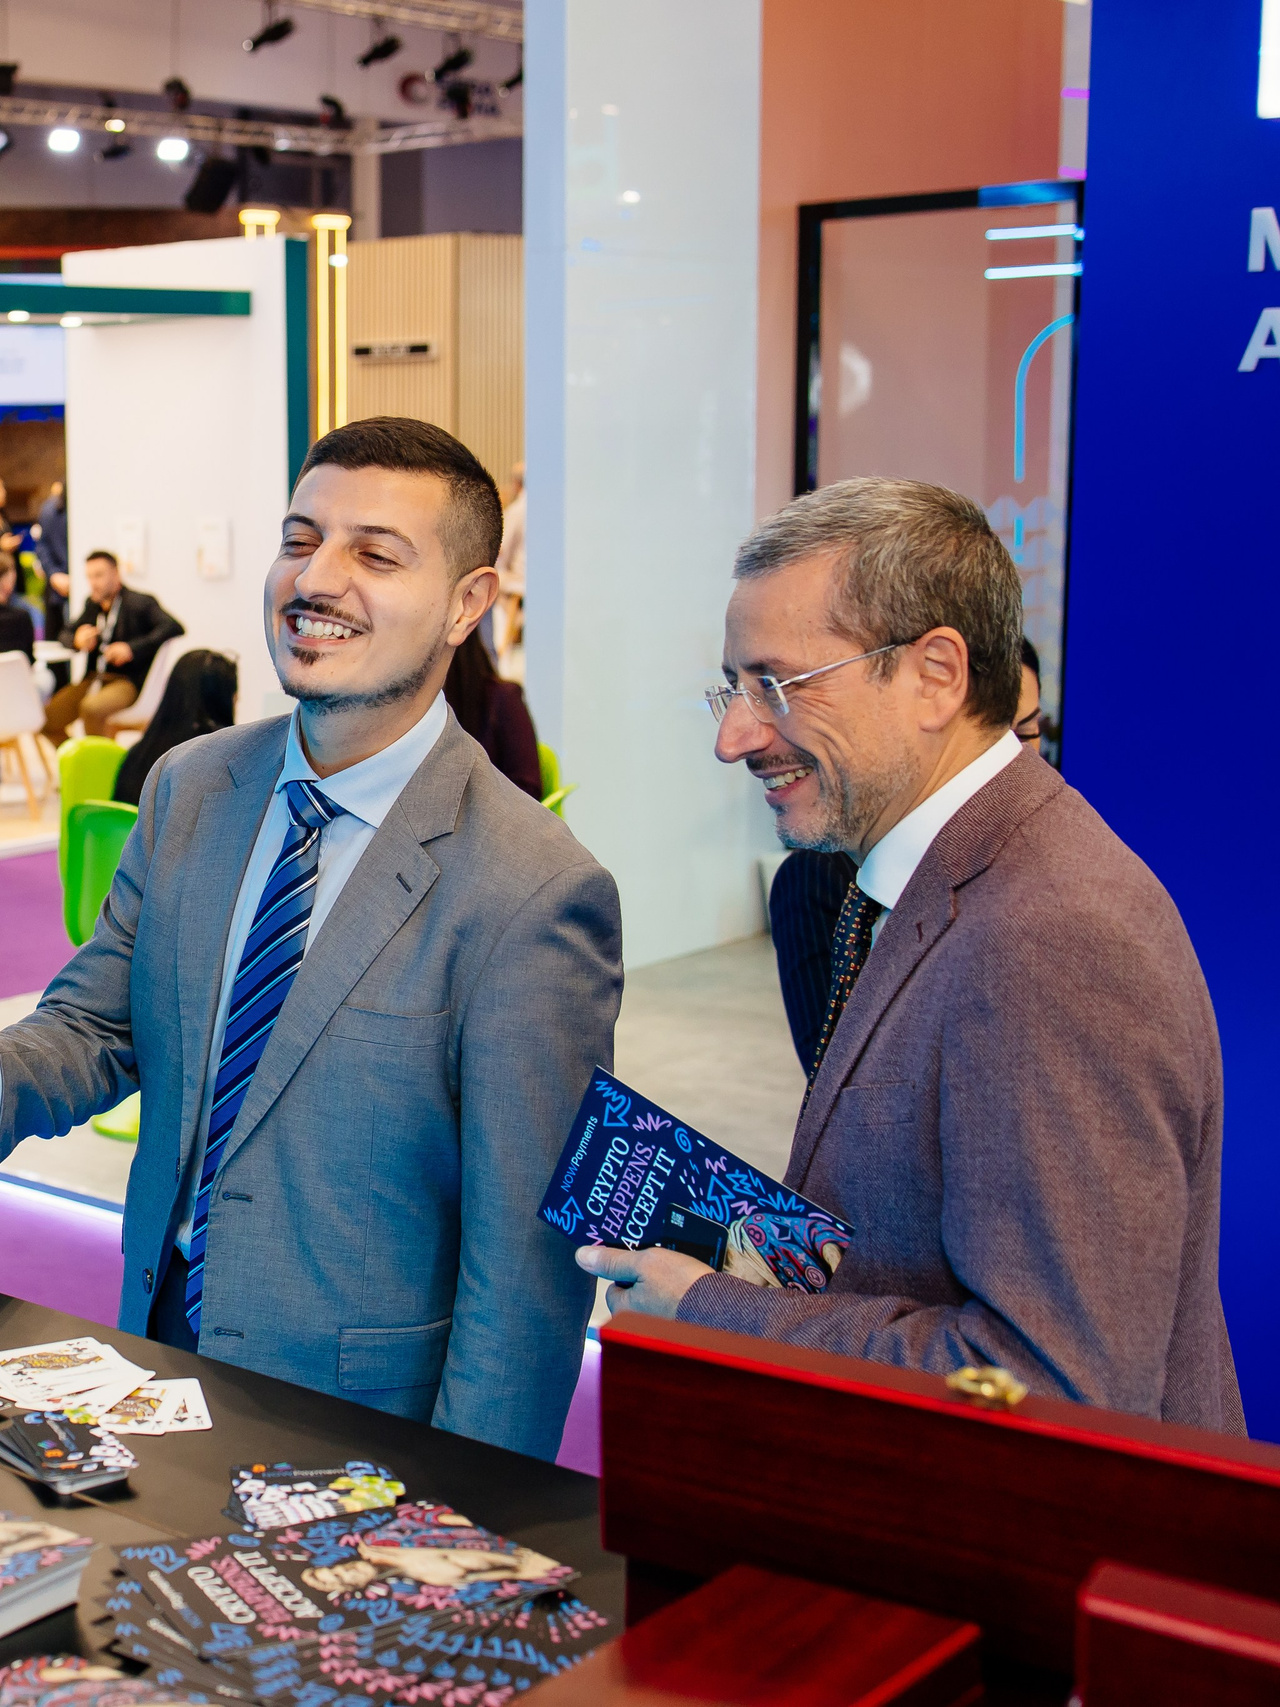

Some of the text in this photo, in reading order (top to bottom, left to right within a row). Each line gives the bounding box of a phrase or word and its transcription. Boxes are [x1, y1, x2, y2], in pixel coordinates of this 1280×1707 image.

[560, 1115, 599, 1193] NOWPayments
[586, 1136, 630, 1216] CRYPTO
[601, 1141, 657, 1239] HAPPENS.
[620, 1146, 676, 1252] ACCEPT IT
